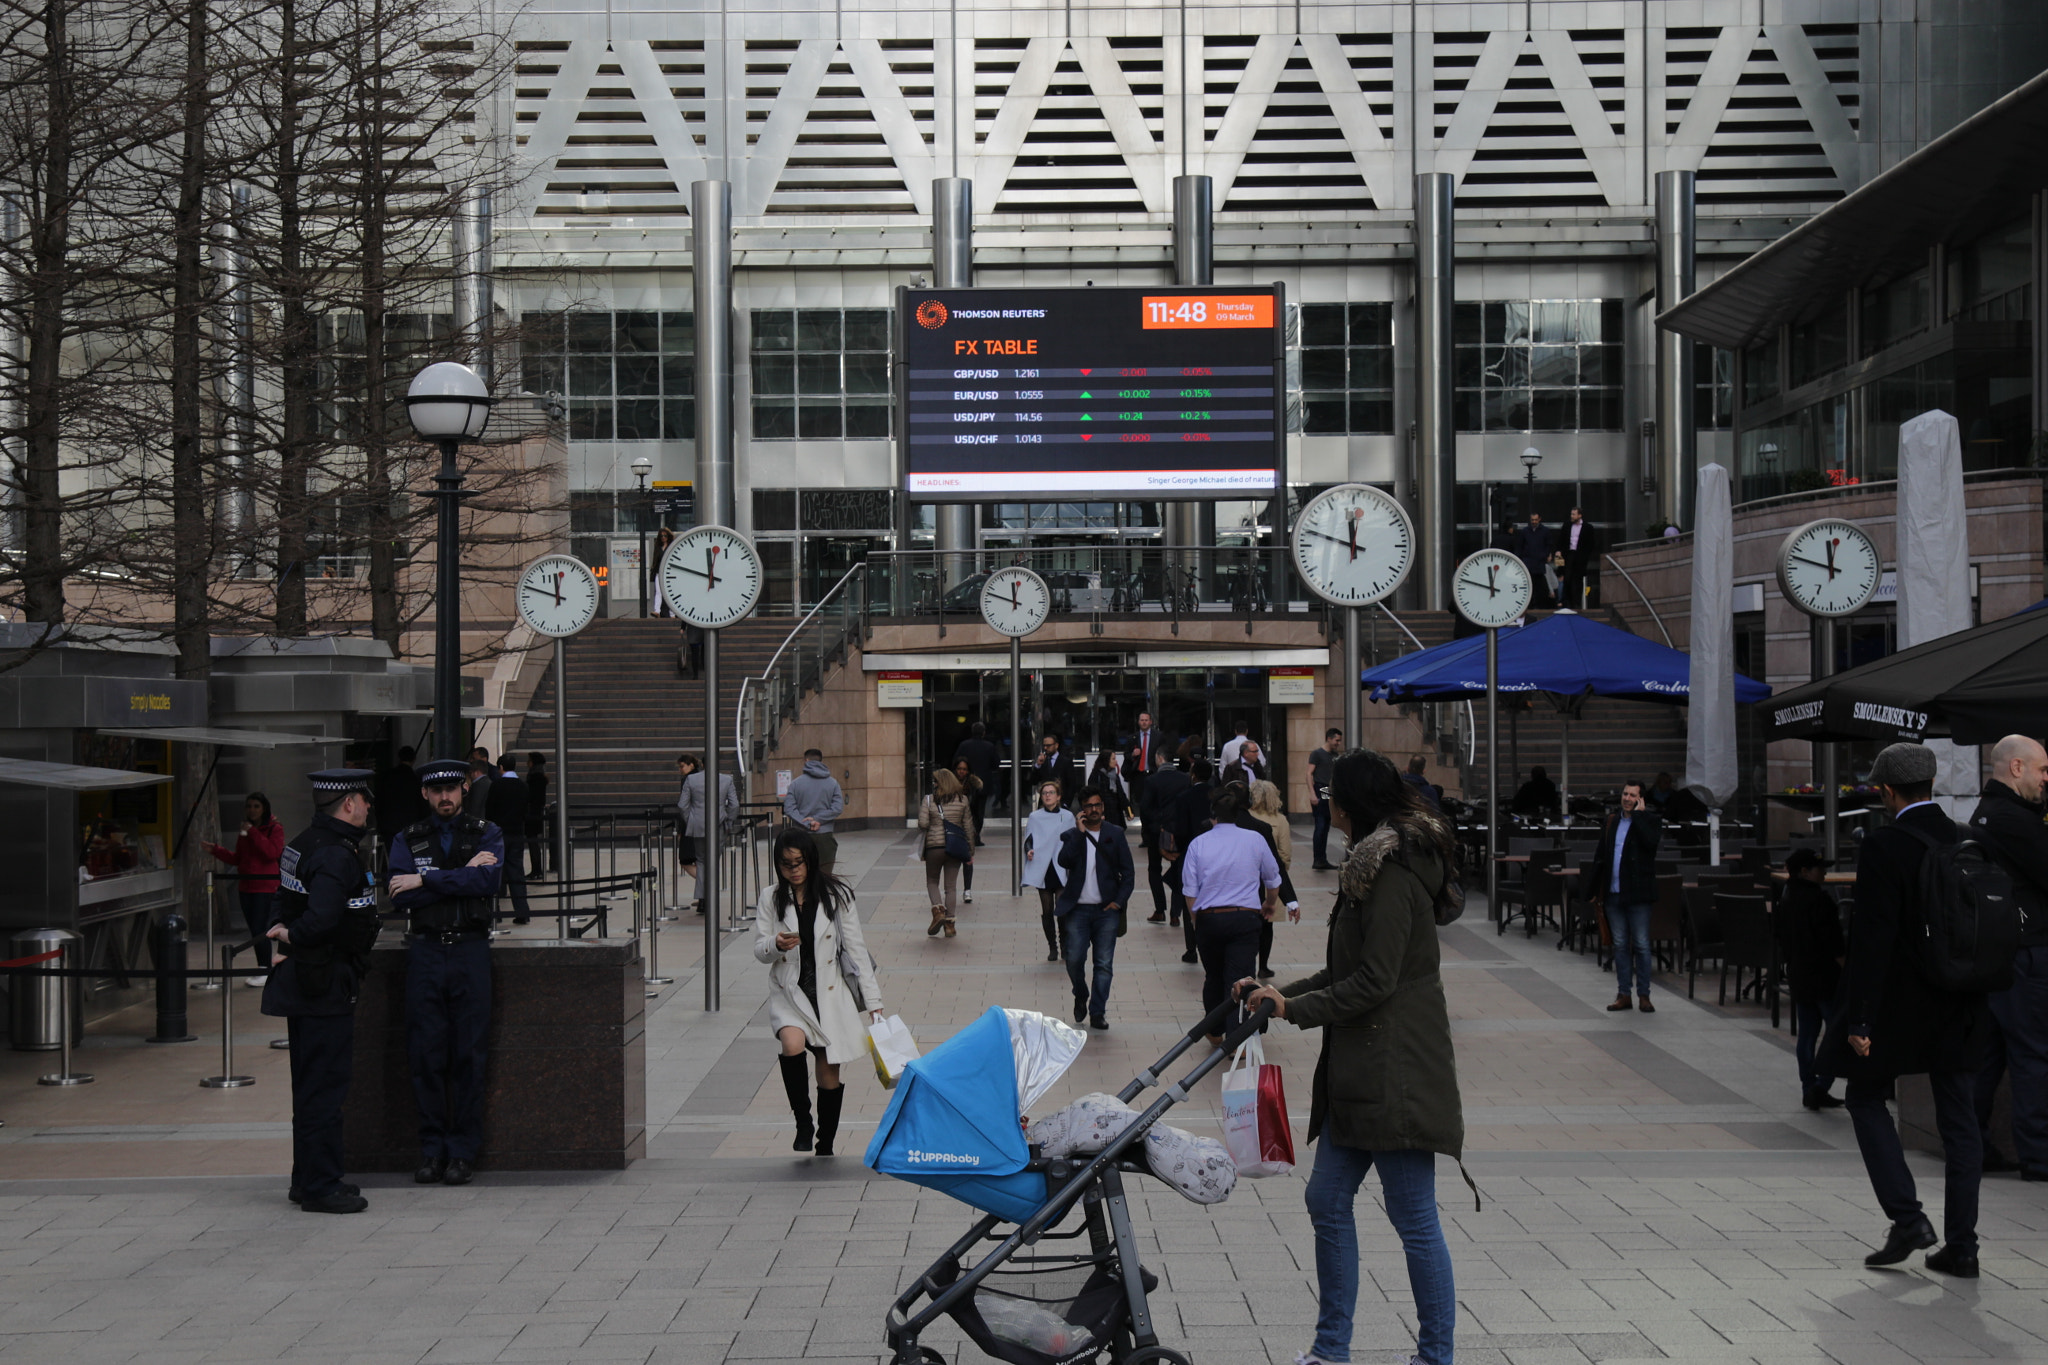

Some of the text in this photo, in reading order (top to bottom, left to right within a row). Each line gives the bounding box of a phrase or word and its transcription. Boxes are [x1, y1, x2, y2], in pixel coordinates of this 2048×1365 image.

[1148, 302, 1207, 323] 11:48
[1216, 303, 1254, 312] Thursday
[952, 310, 1000, 319] THOMSON
[1229, 313, 1255, 321] March
[954, 339, 1038, 355] FX TABLE
[953, 369, 999, 379] GBP/USD
[1014, 369, 1040, 378] 1.2161
[954, 389, 1212, 401] EUR/USD 1.0555 +0.002 +0.15%
[953, 413, 996, 422] USD/JPY
[1014, 412, 1043, 422] 114.56
[1118, 412, 1143, 421] +0.24
[954, 435, 999, 445] USD/CHF
[1014, 434, 1042, 443] 1.0143
[1147, 477, 1170, 485] Singer
[1171, 476, 1198, 485] George
[542, 574, 551, 584] 11
[1511, 584, 1518, 593] 3
[1814, 583, 1822, 595] 7
[1027, 608, 1033, 616] 4
[1853, 702, 1928, 730] SMOLLENSKY'S
[1137, 1107, 1163, 1132] CRUZ
[921, 1152, 980, 1166] UPPAbaby
